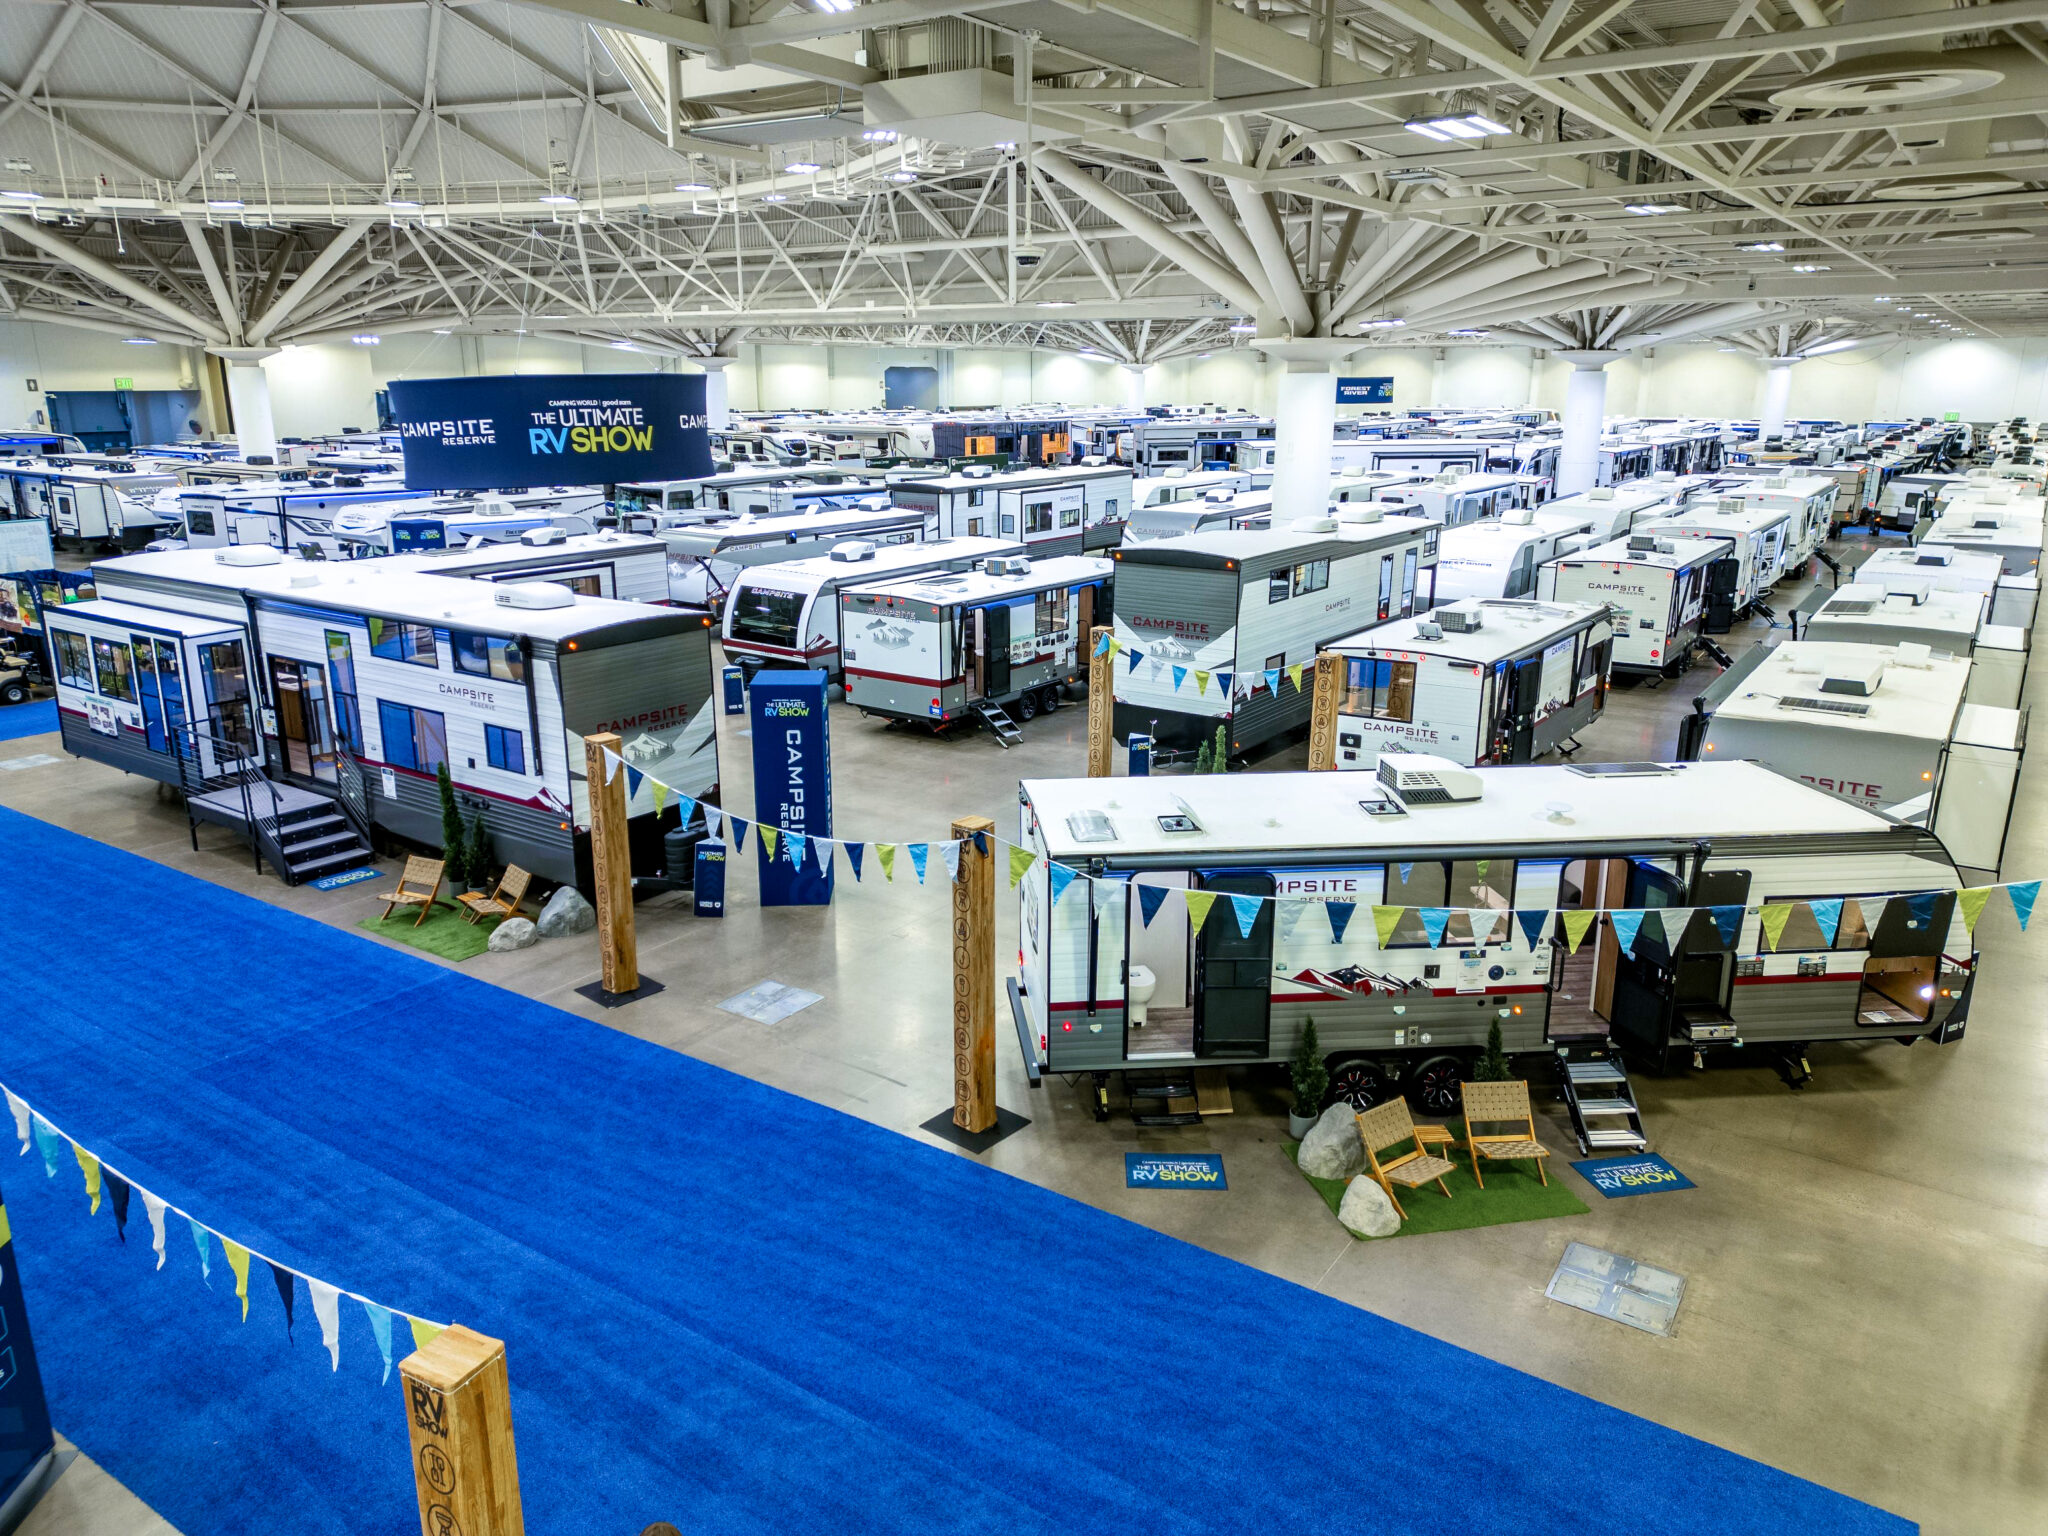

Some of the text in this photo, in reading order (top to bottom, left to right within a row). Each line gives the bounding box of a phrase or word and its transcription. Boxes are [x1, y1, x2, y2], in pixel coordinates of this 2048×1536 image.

[116, 378, 133, 389] EXIT
[548, 399, 577, 407] CAMPING
[602, 399, 618, 408] good
[530, 407, 644, 427] THE ULTIMATE
[401, 418, 496, 438] CAMPSITE
[441, 435, 497, 446] RESERVE
[528, 425, 654, 455] RV SHOW
[897, 503, 936, 511] CAMPSITE
[1136, 527, 1184, 537] CAMPSITE
[750, 586, 795, 599] CAMPSITE
[1587, 582, 1646, 593] CAMPSITE
[867, 607, 916, 620] CAMPSITE
[1132, 615, 1210, 634] CAMPSITE
[1174, 632, 1210, 642] RESERVE
[1319, 658, 1333, 670] RV
[438, 683, 495, 703] CAMPSITE
[774, 701, 806, 709] ULTIMATE
[596, 703, 689, 734] CAMPSITE
[764, 707, 810, 717] RV SHOW
[647, 718, 688, 734] RESERVE
[1363, 722, 1440, 740] CAMPSITE
[1404, 735, 1440, 745] RESERVE
[785, 729, 806, 862] CAMPSI
[1152, 1164, 1211, 1173] ULTIMATE
[1606, 1164, 1664, 1178] ULTIMATE
[1132, 1170, 1218, 1182] RV SHOW
[1595, 1170, 1678, 1190] RV SHOW
[410, 1384, 444, 1424] RV
[415, 1415, 449, 1440] SHOW
